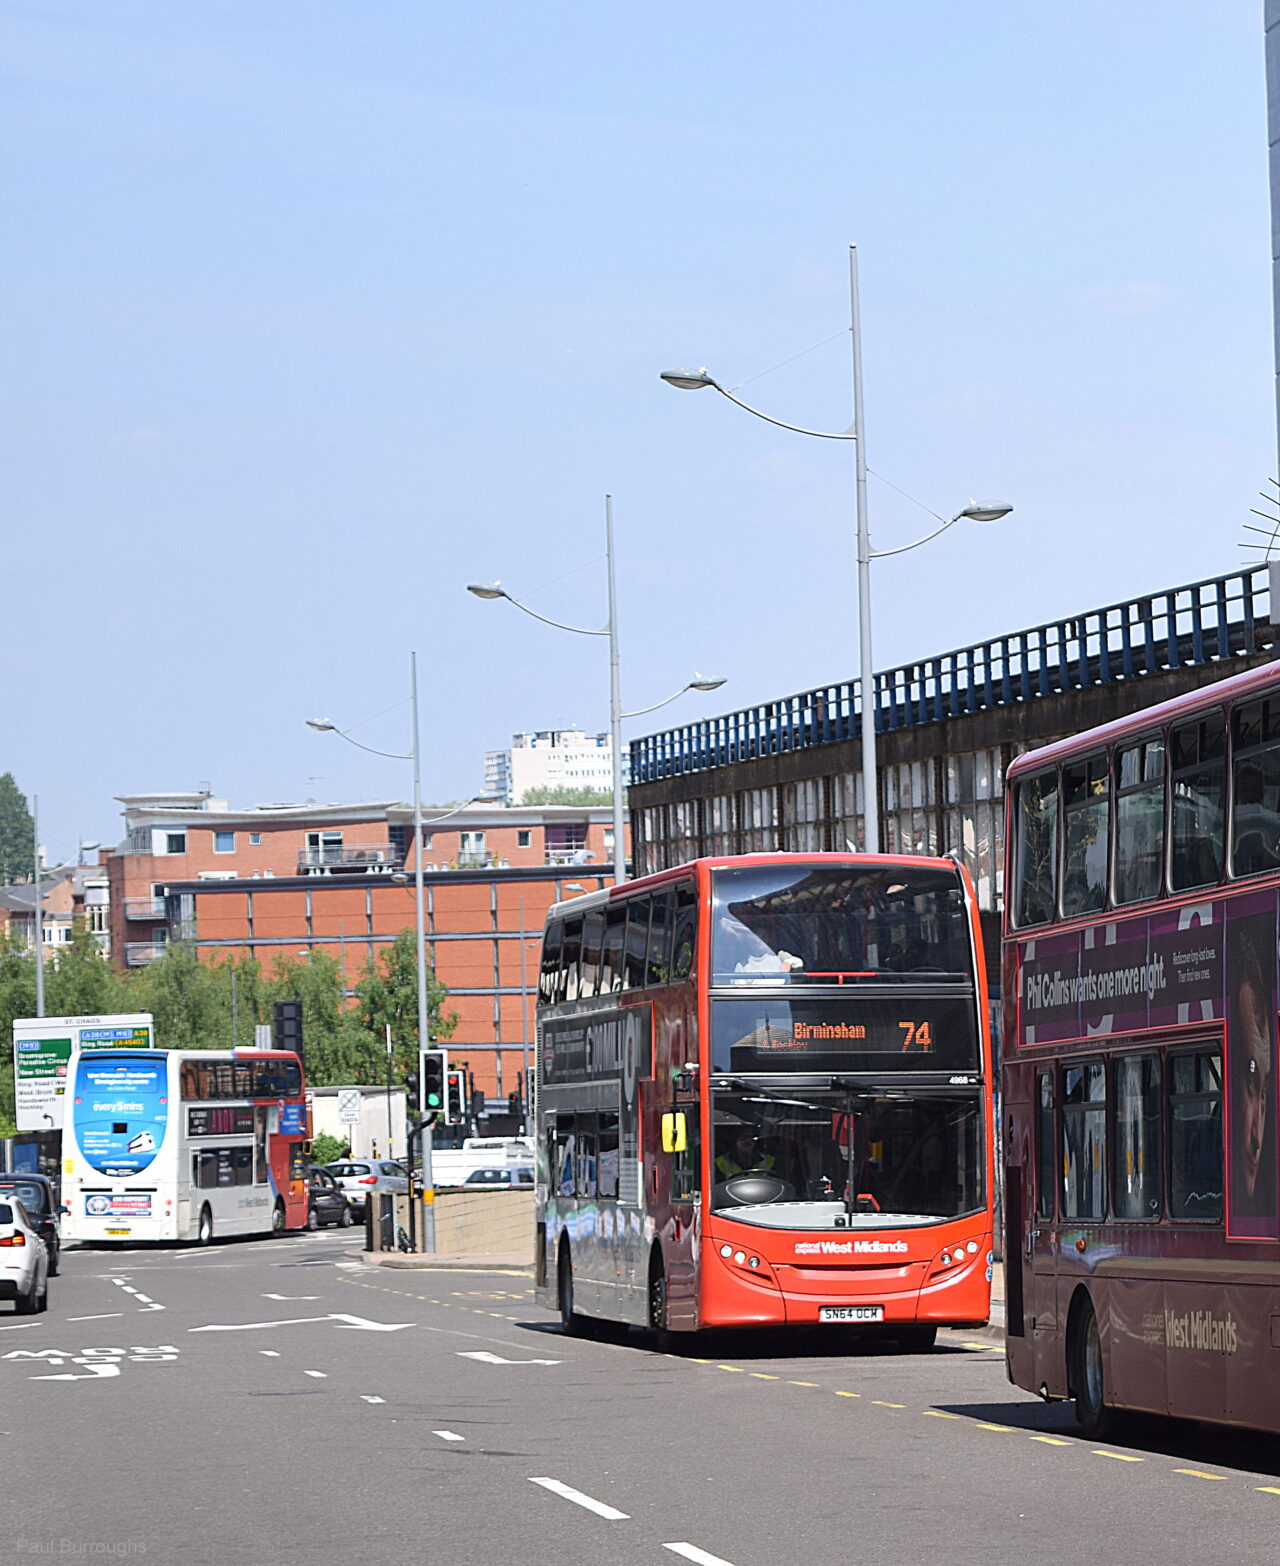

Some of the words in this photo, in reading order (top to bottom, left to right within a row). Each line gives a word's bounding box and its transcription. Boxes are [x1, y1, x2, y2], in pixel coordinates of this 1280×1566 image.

[1172, 951, 1191, 966] Rediscover
[1027, 974, 1041, 1010] Phil
[1041, 970, 1069, 1007] Collins
[1069, 968, 1097, 1002] wants
[1098, 971, 1115, 999] one
[1115, 967, 1140, 996] more
[1140, 952, 1166, 1000] night.
[793, 1022, 866, 1039] Birmingham
[898, 1021, 931, 1052] 74
[19, 1052, 57, 1060] Bromsgrove
[949, 1076, 968, 1084] 4968
[822, 1241, 853, 1254] West
[854, 1240, 908, 1253] Midlands
[825, 1308, 853, 1320] SN64
[1142, 1312, 1164, 1328] national
[1165, 1308, 1189, 1348] West
[1190, 1310, 1238, 1352] Midlands
